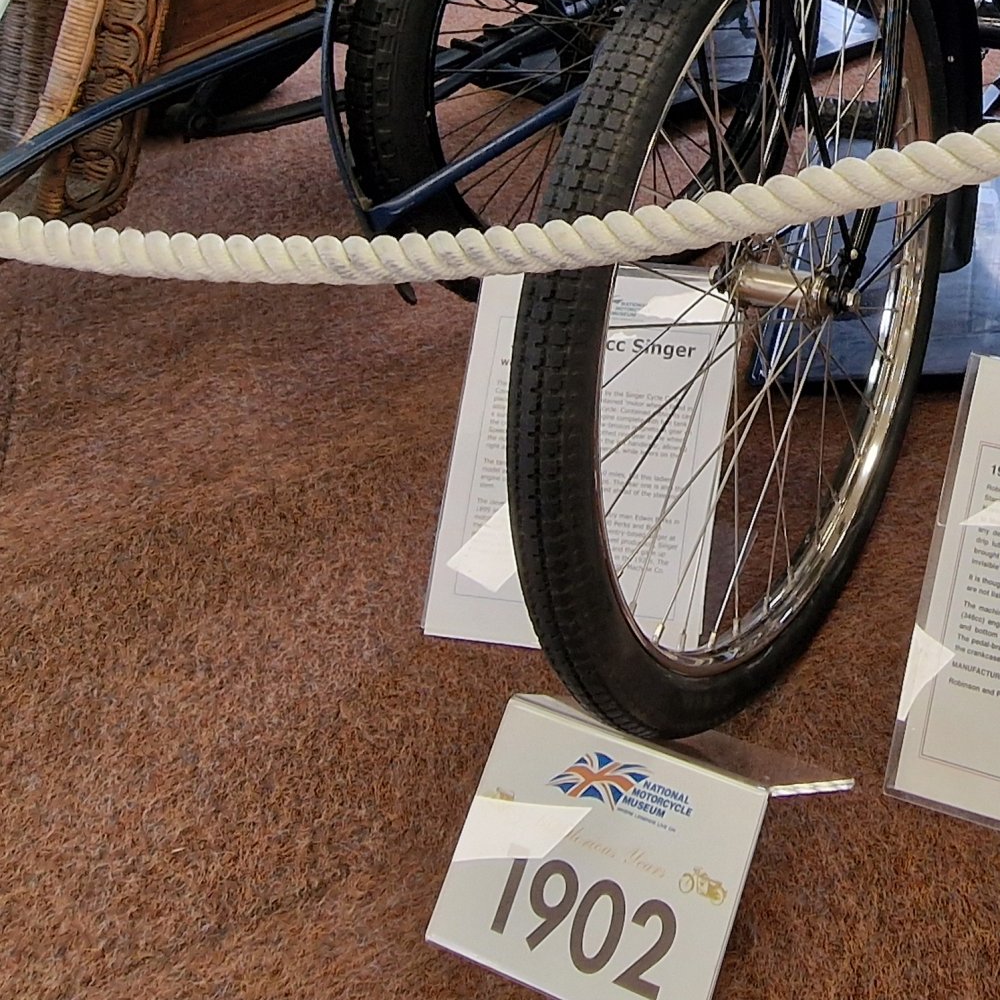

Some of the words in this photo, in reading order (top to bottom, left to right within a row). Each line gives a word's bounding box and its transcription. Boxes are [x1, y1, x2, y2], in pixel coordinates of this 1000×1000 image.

[632, 338, 696, 360] Singer
[632, 787, 693, 817] MOTORCYCLE
[643, 780, 689, 804] NATIONAL
[622, 795, 666, 818] MUSEUM
[490, 852, 677, 1000] 1902
